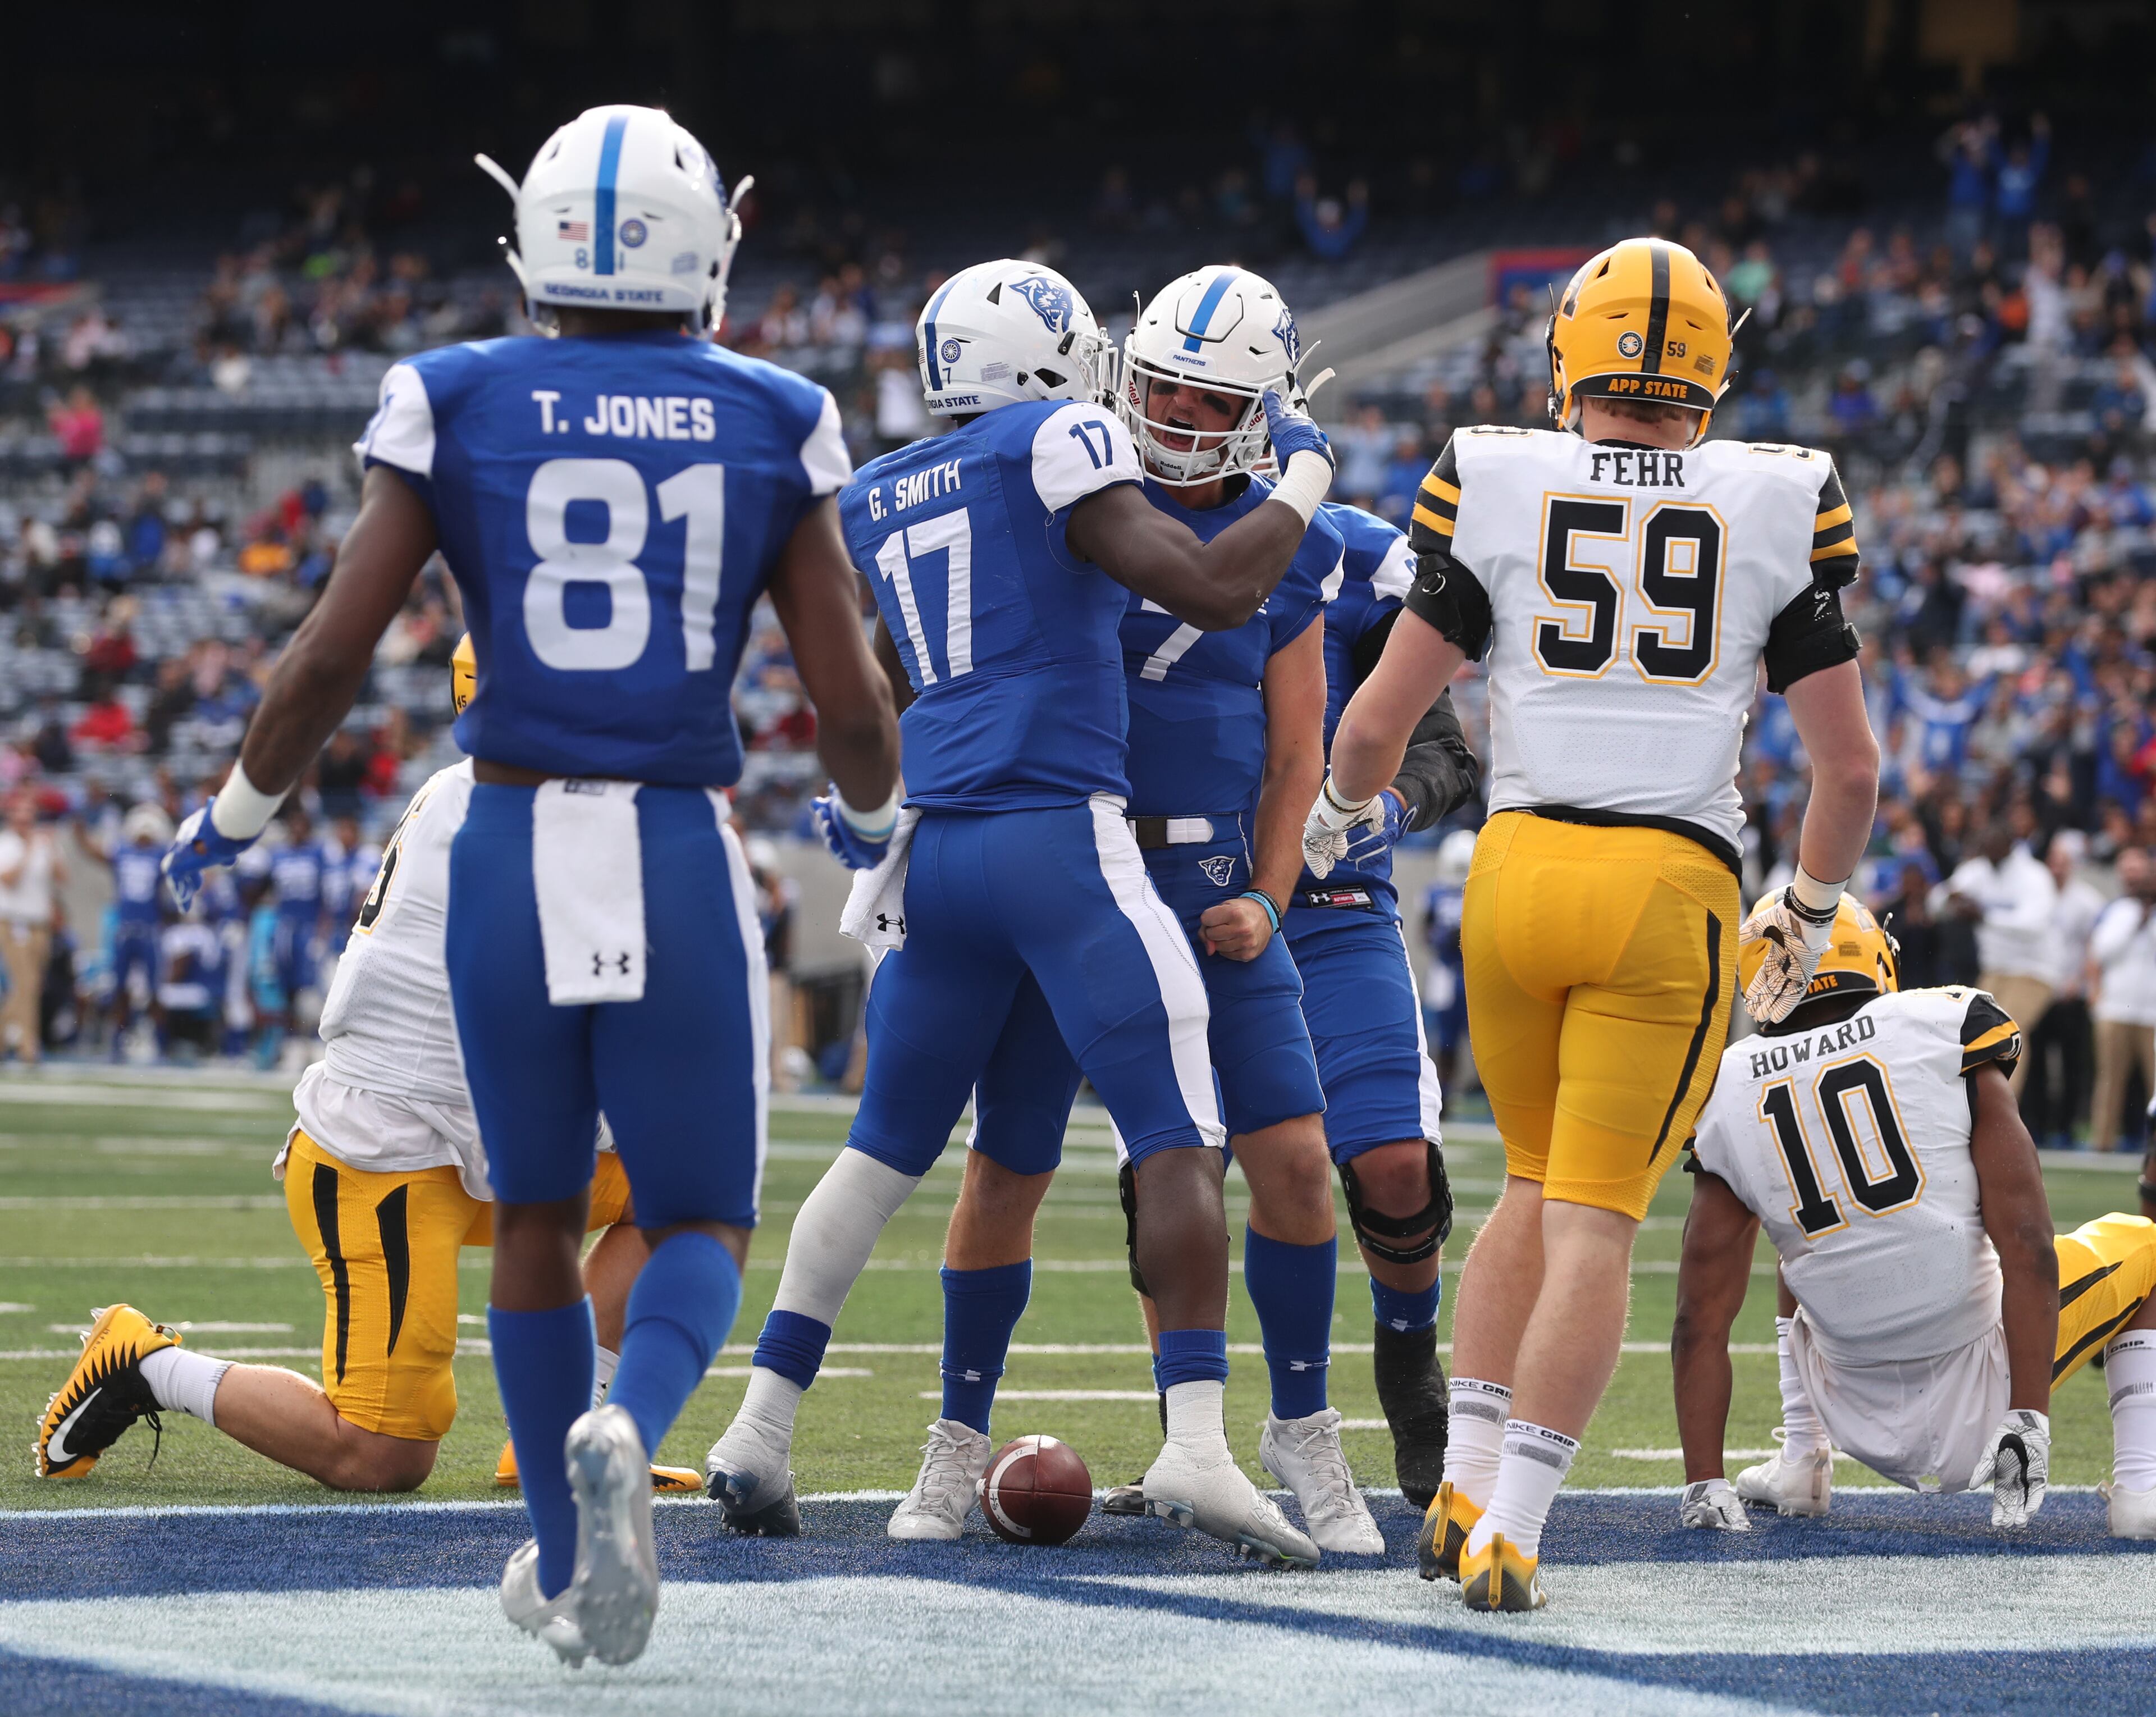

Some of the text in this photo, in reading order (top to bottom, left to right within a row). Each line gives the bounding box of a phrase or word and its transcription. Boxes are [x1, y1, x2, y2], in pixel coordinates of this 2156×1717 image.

[615, 289, 664, 303] STATE
[1172, 354, 1206, 367] PANTHERS
[1666, 341, 1686, 358] 59
[945, 395, 981, 408] STATE
[1607, 378, 1688, 399] APP STATE
[531, 391, 716, 441] T. JONES
[1068, 420, 1113, 470] 17
[1589, 453, 1686, 488] FEHR
[868, 458, 962, 522] G. SMITH
[523, 458, 725, 672] 81
[874, 506, 974, 686] 17
[1532, 491, 1728, 687] 59
[457, 695, 467, 709] 45
[1750, 1015, 1876, 1079] HOWARD
[1757, 1051, 1926, 1241] 10
[1450, 1380, 1479, 1389] NIKE
[1506, 1422, 1575, 1447] NIKE GRIP
